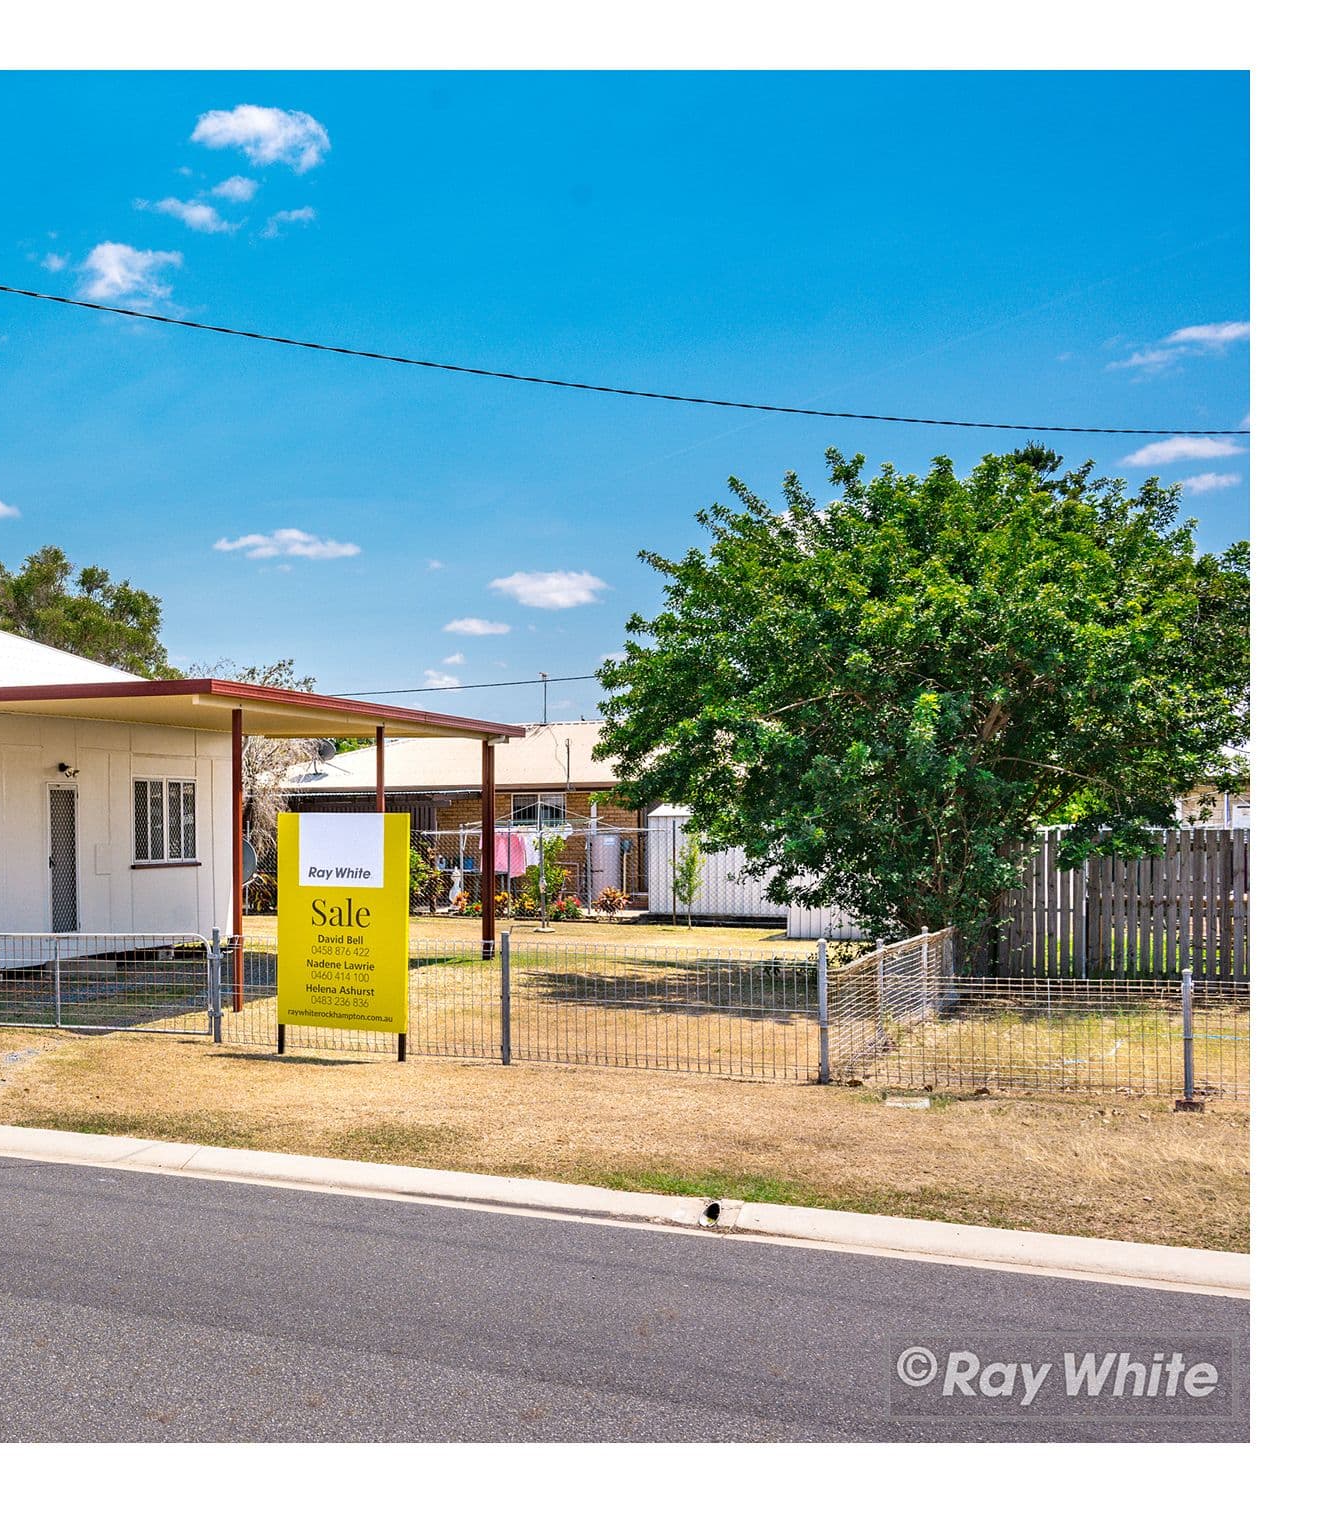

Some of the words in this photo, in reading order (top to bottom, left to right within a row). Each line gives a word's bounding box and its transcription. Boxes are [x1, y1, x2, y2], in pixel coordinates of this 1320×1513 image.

[308, 866, 333, 880] Ray
[335, 867, 371, 879] White
[311, 898, 371, 928] Sale
[317, 934, 344, 944] David
[346, 935, 364, 945] Bell
[311, 945, 333, 955] 0458
[335, 946, 352, 956] 876
[353, 947, 370, 957] 422
[306, 959, 342, 970] Nadene
[344, 961, 375, 972] Lawrie
[311, 970, 333, 981] 0460
[335, 972, 351, 982] 414
[354, 973, 370, 983] 100
[306, 984, 337, 994] Helena
[339, 986, 375, 997] Ashurst
[311, 995, 333, 1006] 0483
[335, 997, 351, 1007] 236
[353, 998, 369, 1008] 836
[288, 1009, 393, 1023] raywhiterockhampton.com.au
